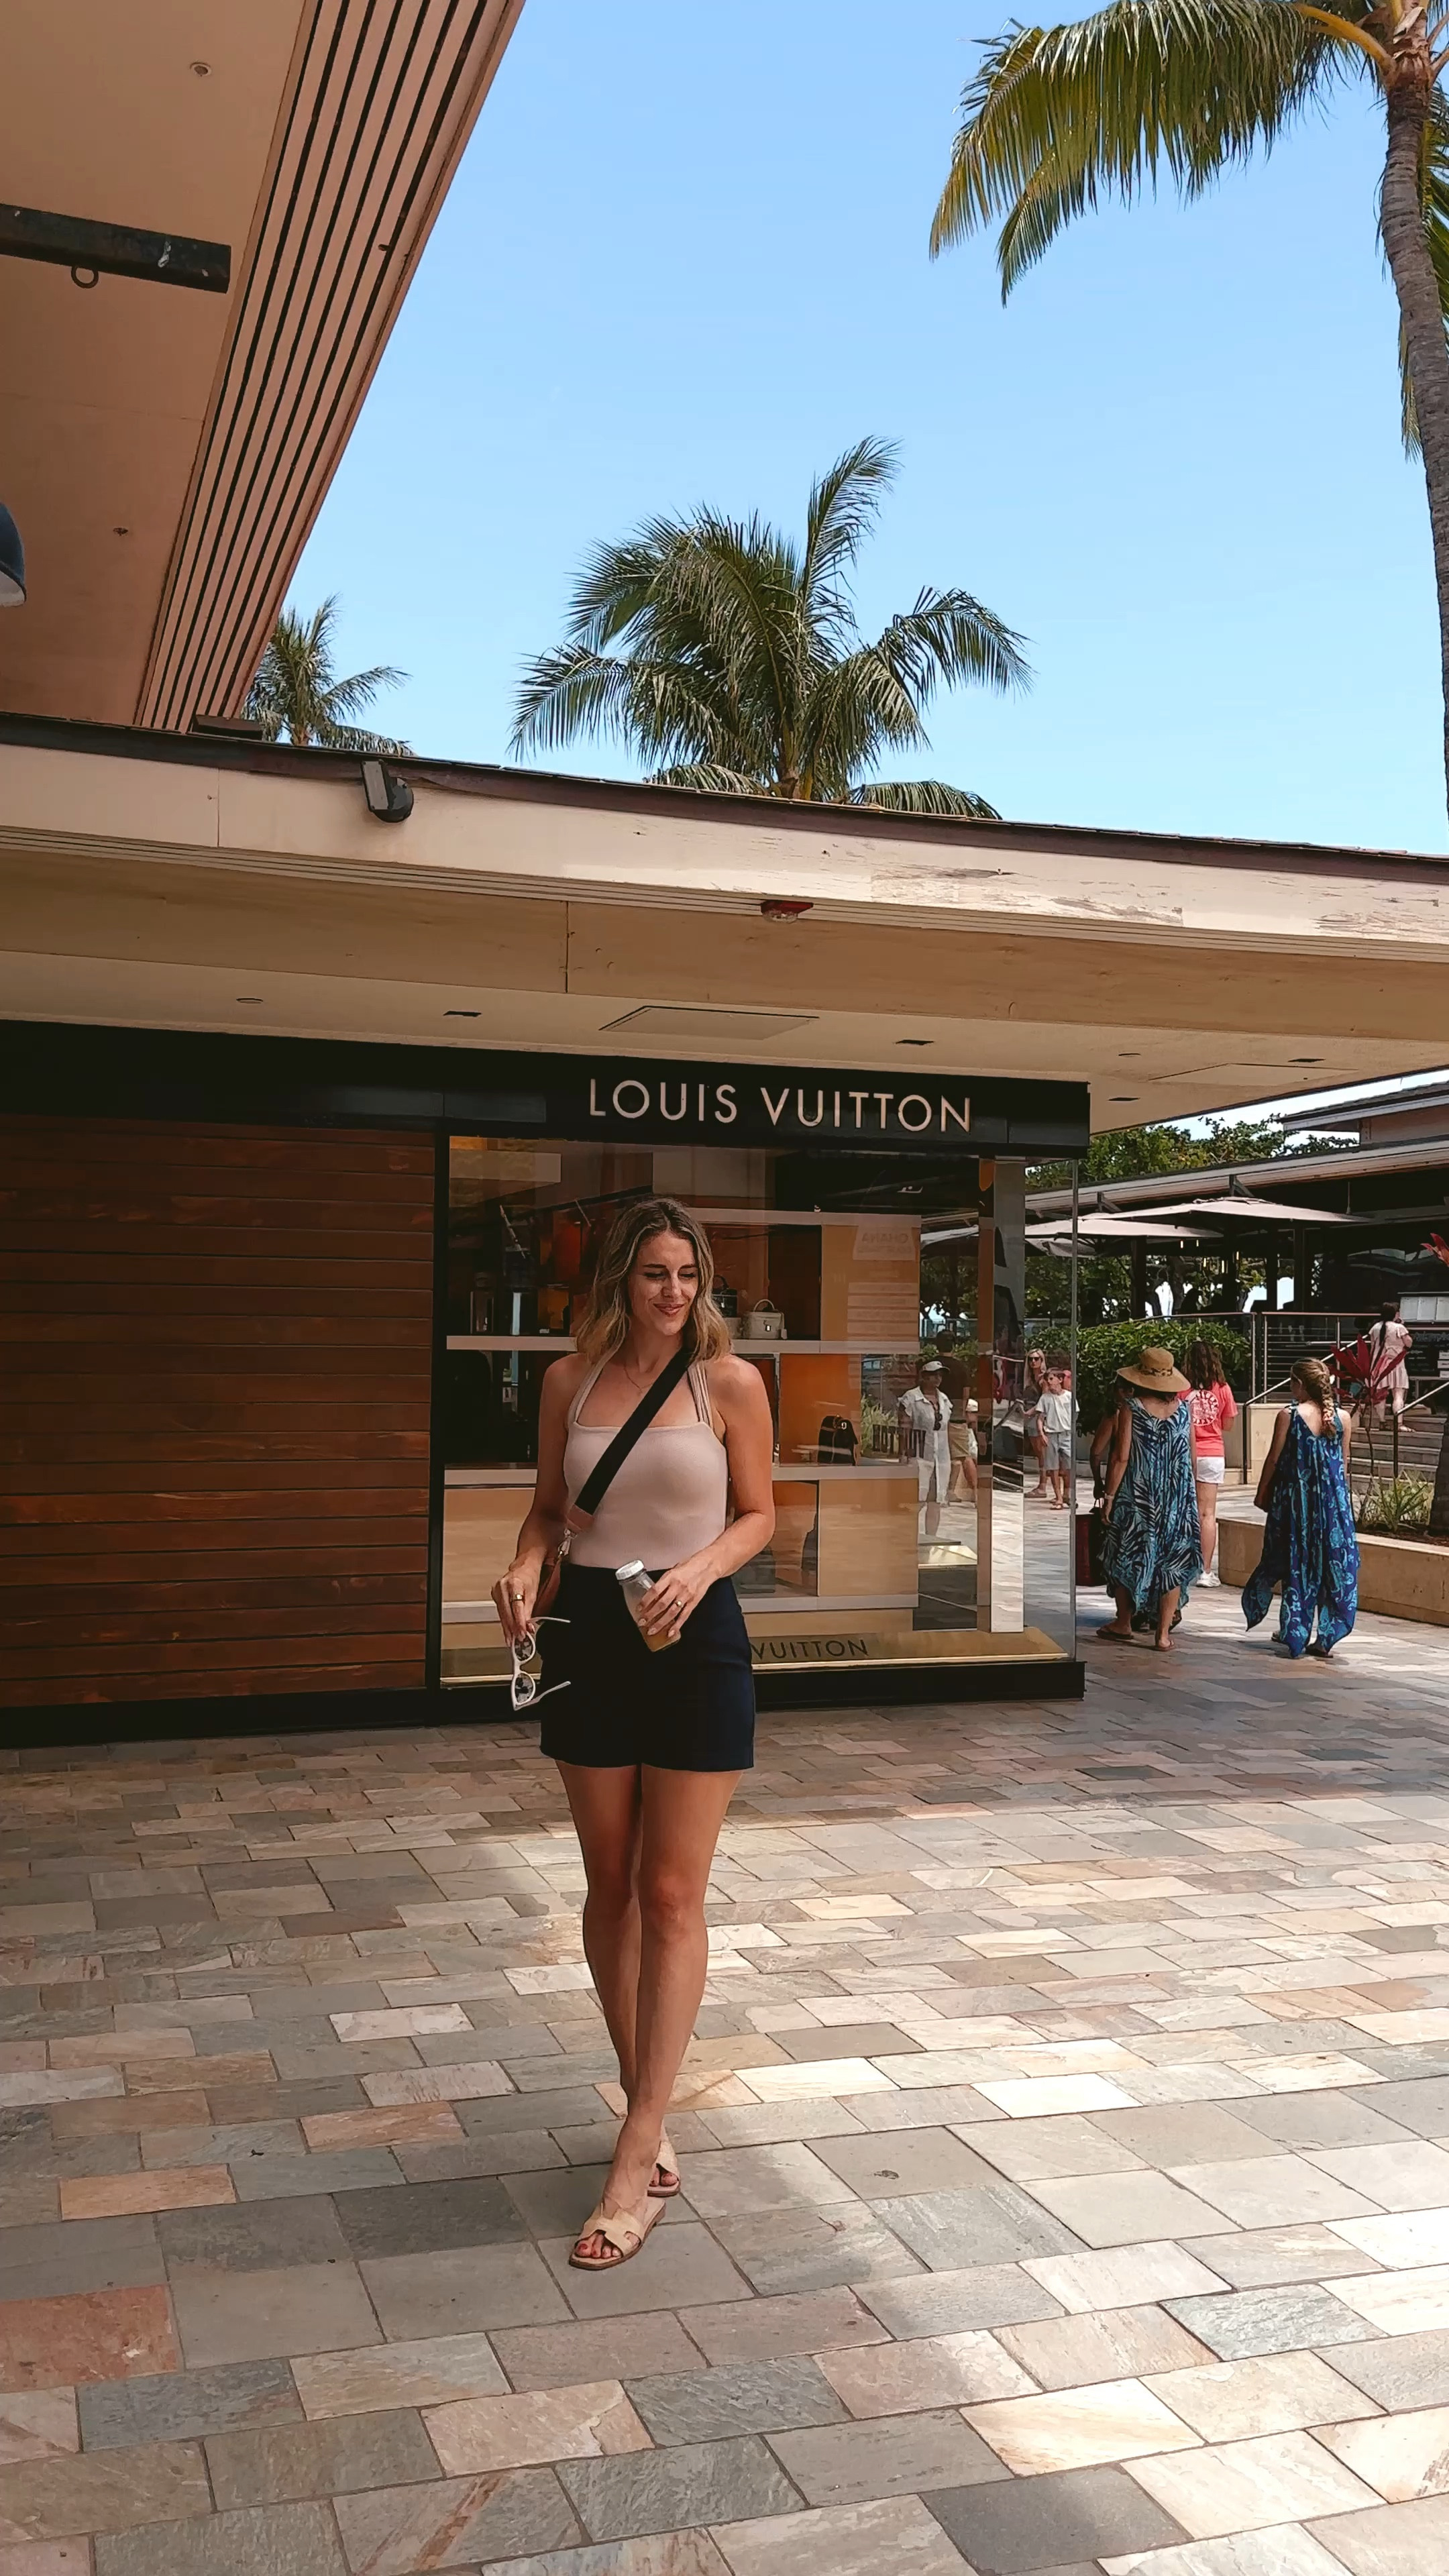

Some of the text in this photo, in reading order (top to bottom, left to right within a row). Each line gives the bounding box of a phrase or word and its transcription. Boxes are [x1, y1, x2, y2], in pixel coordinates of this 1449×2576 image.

[590, 1078, 971, 1133] LOUIS VUITTON
[751, 1639, 869, 1660] VUITTON
